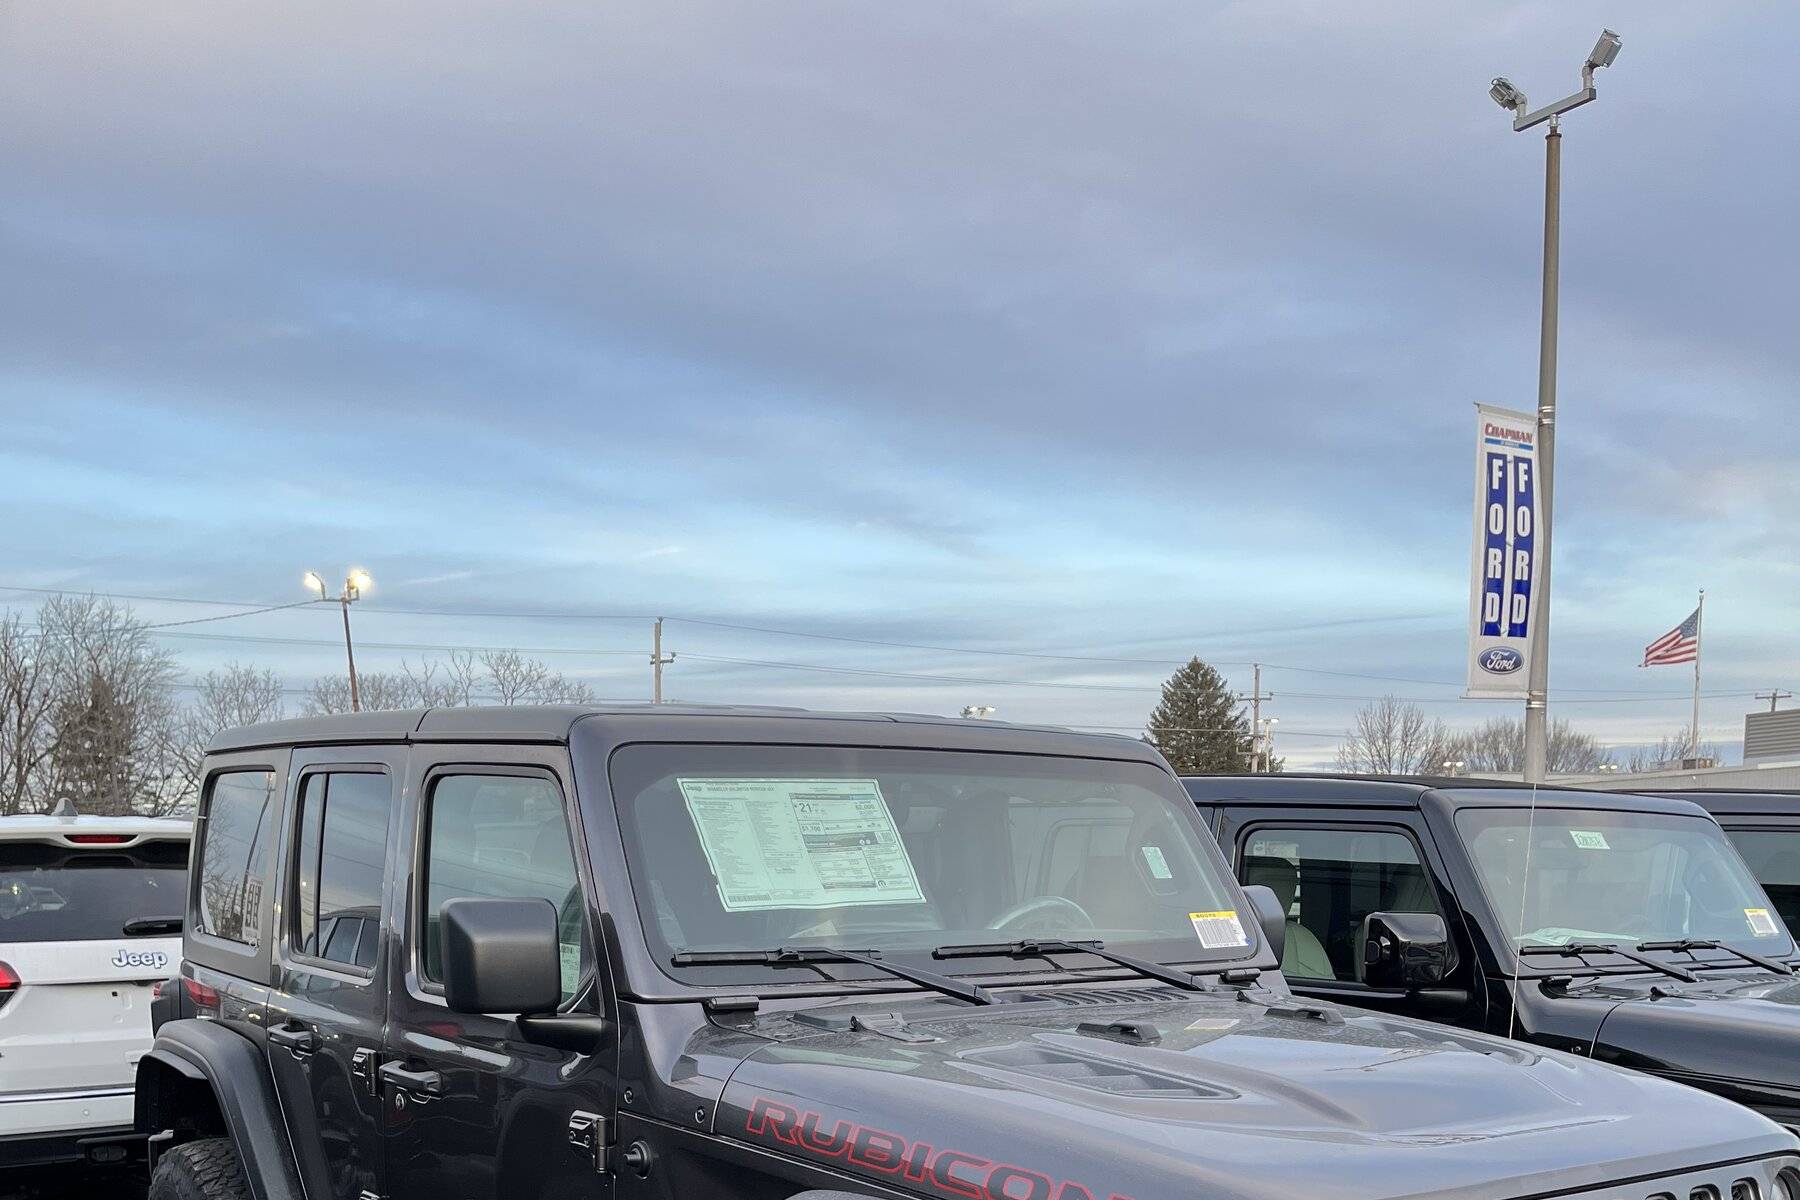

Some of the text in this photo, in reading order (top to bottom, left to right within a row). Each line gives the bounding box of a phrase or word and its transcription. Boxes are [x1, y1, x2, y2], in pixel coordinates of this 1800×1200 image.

[1485, 422, 1533, 443] CHAPMAN
[1485, 458, 1504, 623] FORD
[1512, 462, 1531, 624] FORD
[1486, 651, 1515, 671] Ford
[112, 950, 168, 969] Jeep
